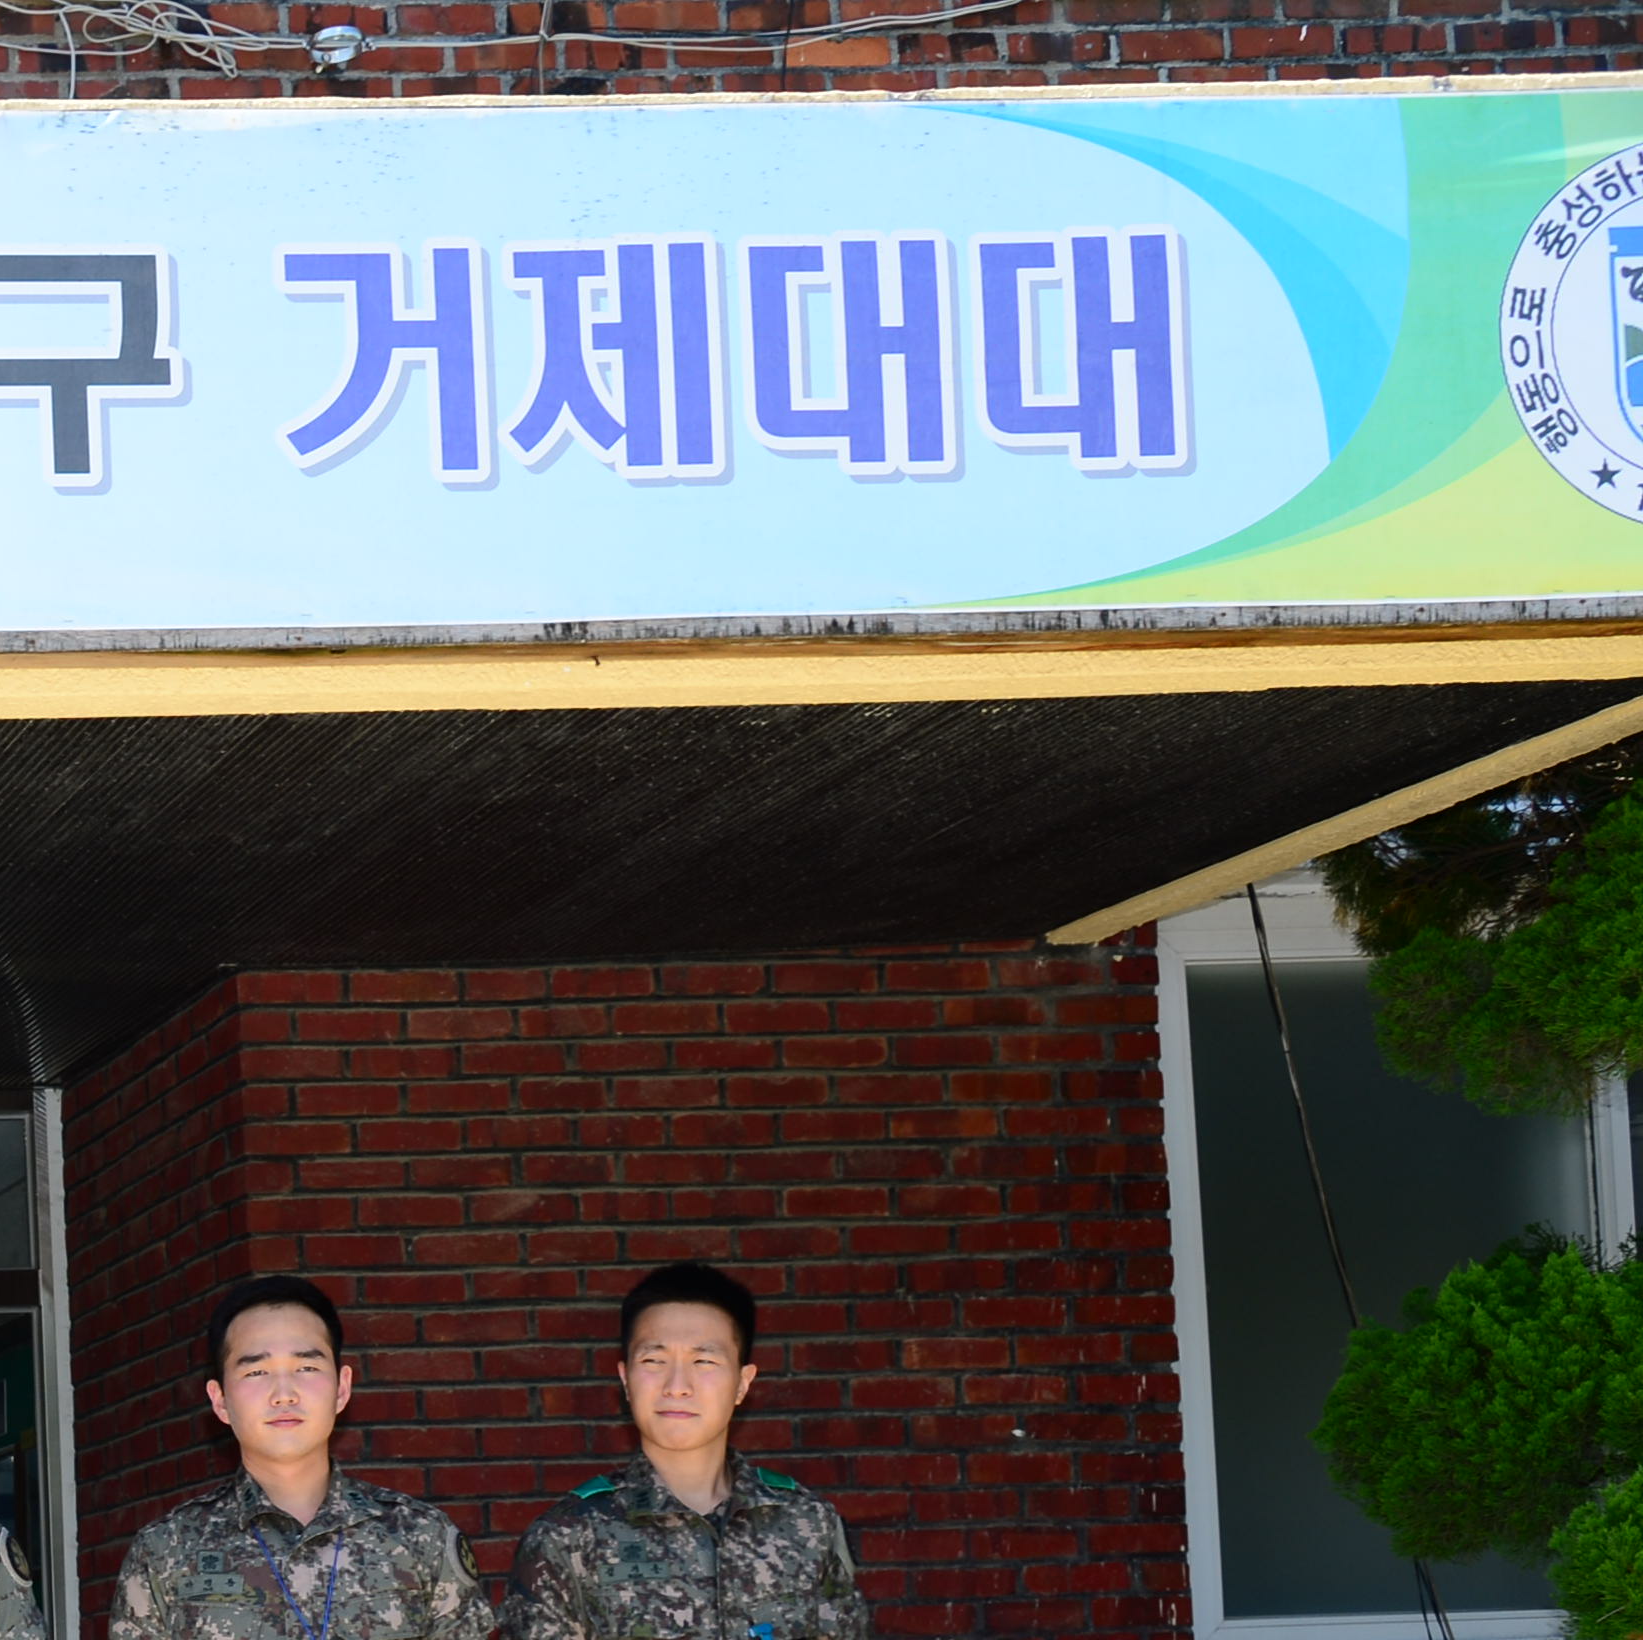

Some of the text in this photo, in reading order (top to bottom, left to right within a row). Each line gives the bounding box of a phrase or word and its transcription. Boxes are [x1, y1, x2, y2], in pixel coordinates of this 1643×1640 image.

[282, 234, 1180, 475] 거제대대
[1509, 152, 1643, 454] 행동으로 충성하
